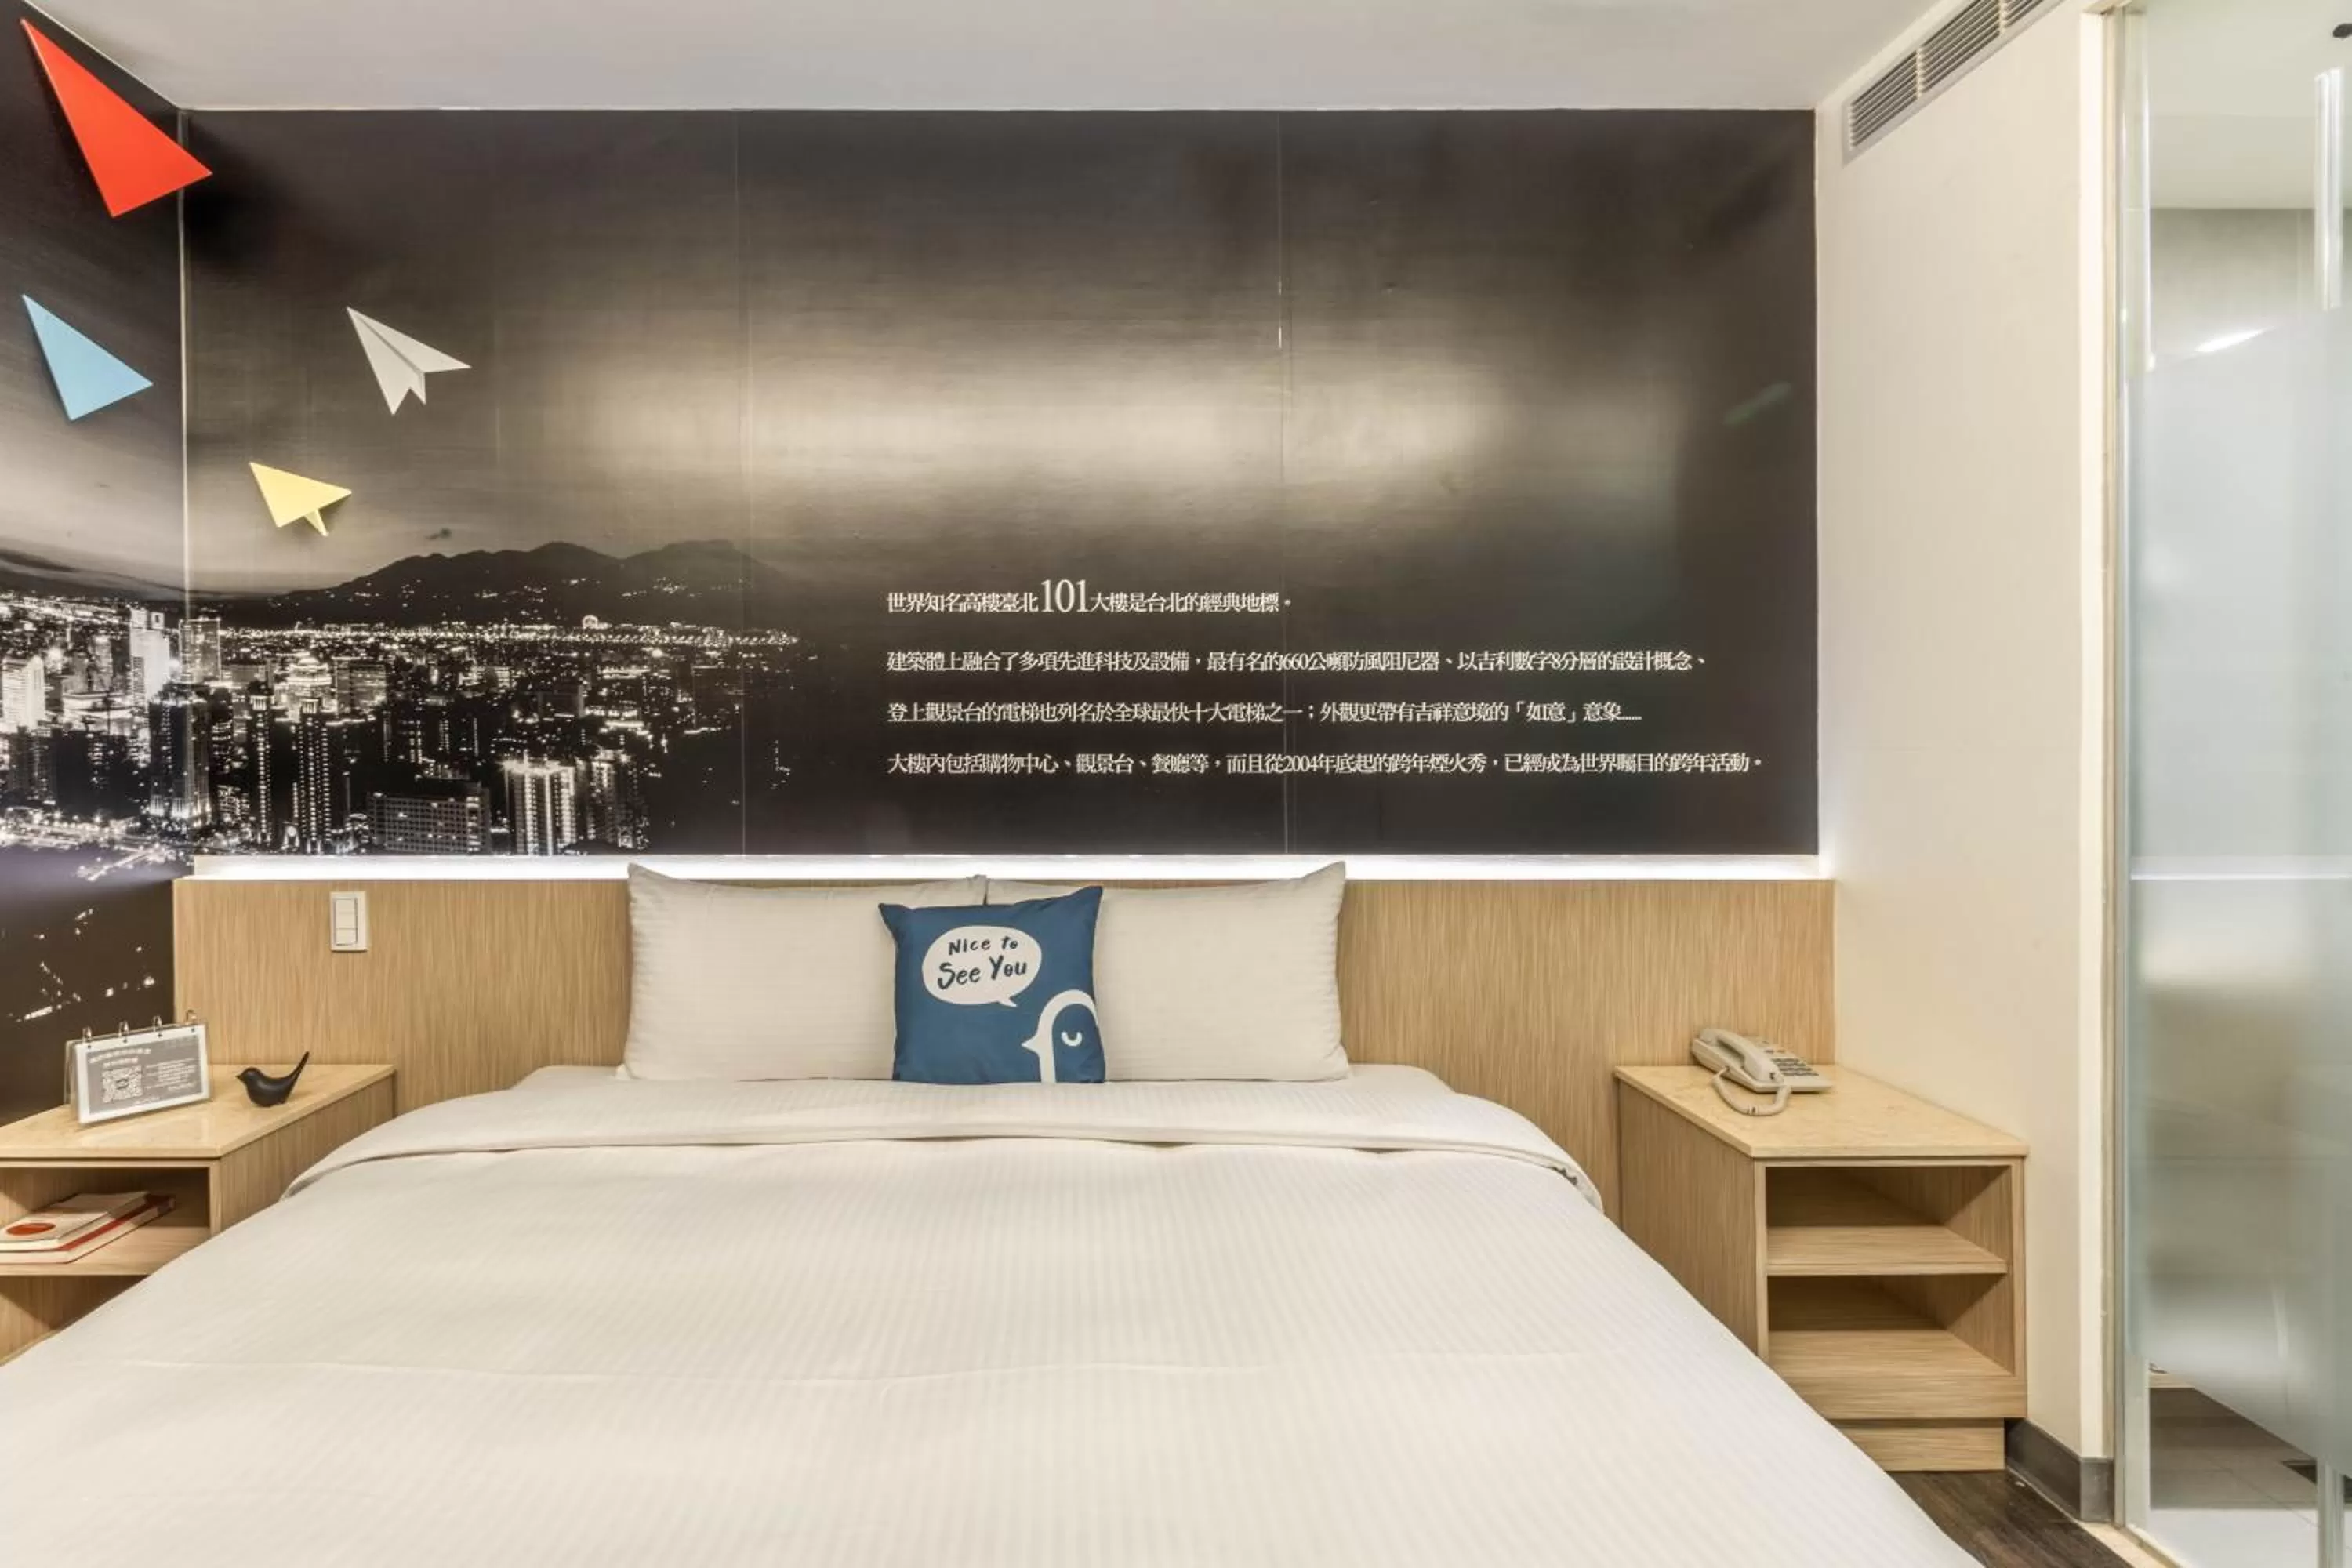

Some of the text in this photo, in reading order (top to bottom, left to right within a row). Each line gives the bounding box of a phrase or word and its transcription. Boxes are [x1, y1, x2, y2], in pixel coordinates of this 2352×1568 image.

[948, 935, 1018, 956] Nice to
[937, 955, 1027, 990] See You
